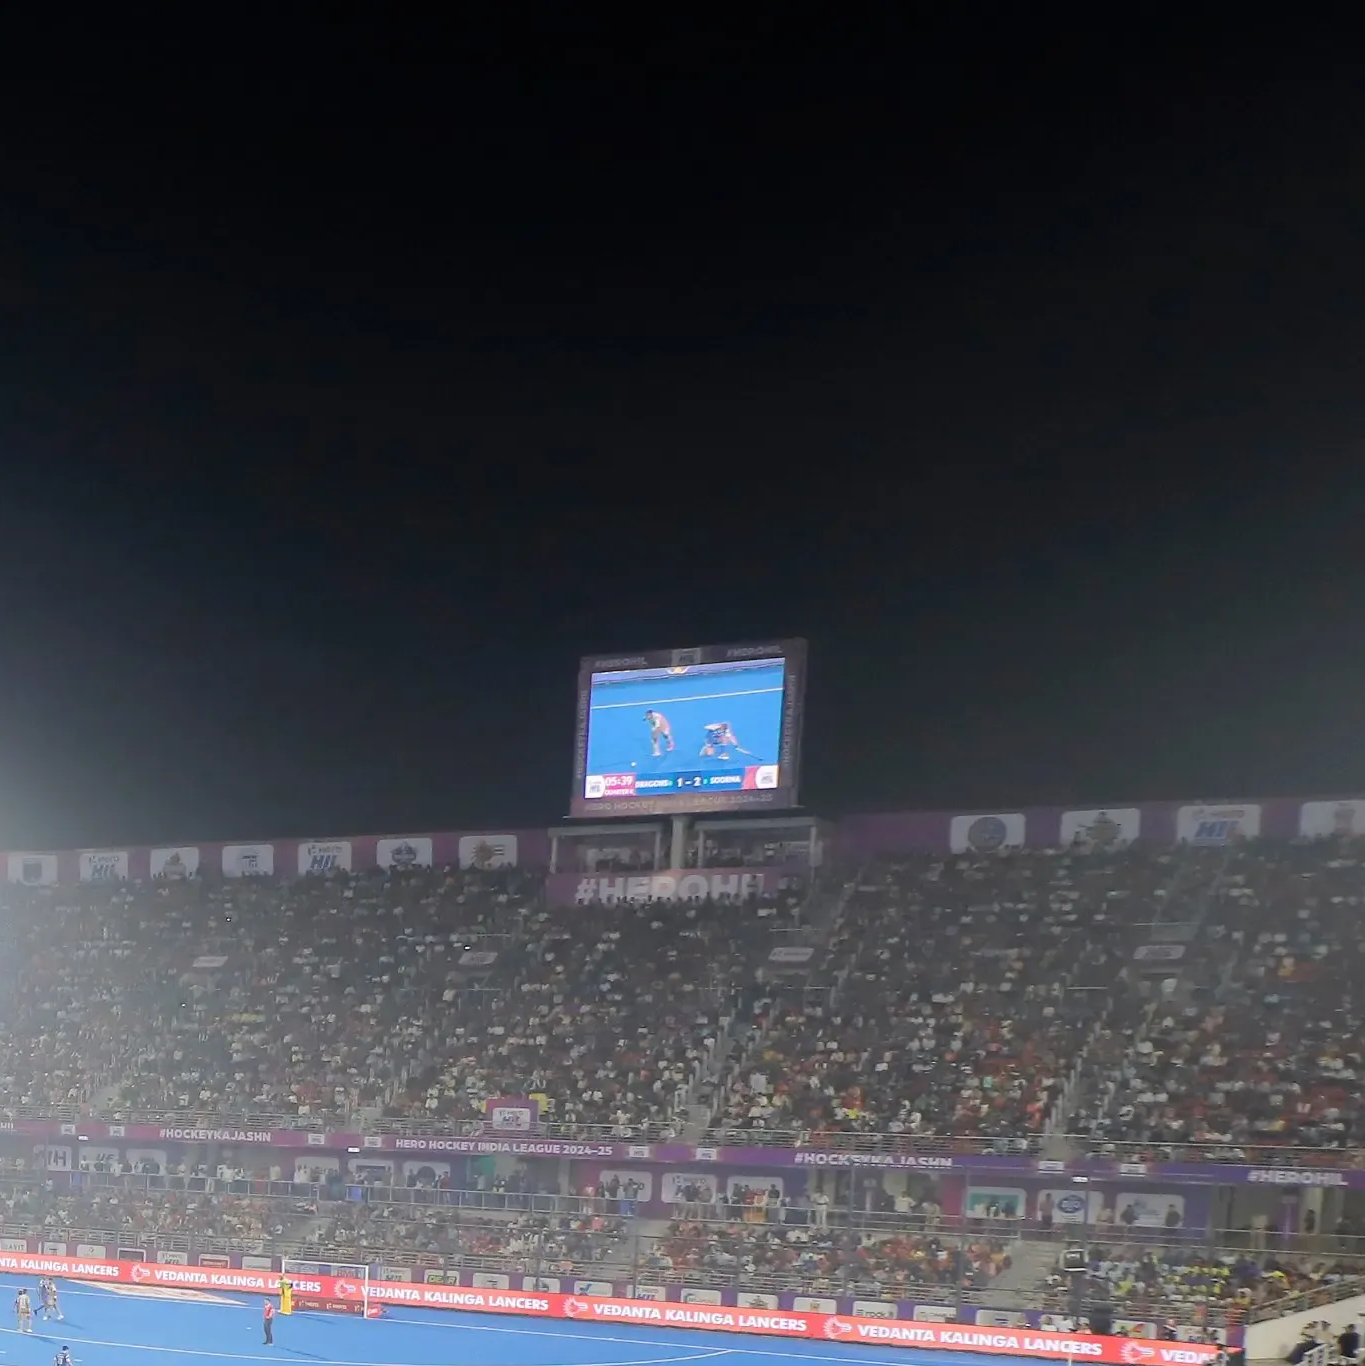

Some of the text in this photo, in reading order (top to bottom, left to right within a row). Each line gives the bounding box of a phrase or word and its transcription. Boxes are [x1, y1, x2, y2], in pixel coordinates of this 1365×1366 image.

[605, 775, 632, 786] 05:39
[635, 779, 668, 789] DRAGONS
[677, 778, 683, 787] 1
[693, 777, 701, 786] 2
[159, 1128, 272, 1142] #HOCKEYKAJASHN
[395, 1138, 426, 1149] HERO
[429, 1140, 475, 1151] HOCKEY
[477, 1142, 510, 1153] INDIA
[513, 1143, 560, 1154] LEAGUE
[1247, 1169, 1349, 1186] #HEROHIL
[21, 1260, 69, 1273] KALINGA
[72, 1263, 119, 1277] LANCERS
[154, 1269, 321, 1293] VEDANTA KALINGA LACERS
[361, 1285, 549, 1311] VEDANTA KALINGA LANCERS
[593, 1304, 807, 1332] VEDANTA KALINGA LANCERS
[857, 1324, 1103, 1356] VEDANTA KALINGA LANCERS
